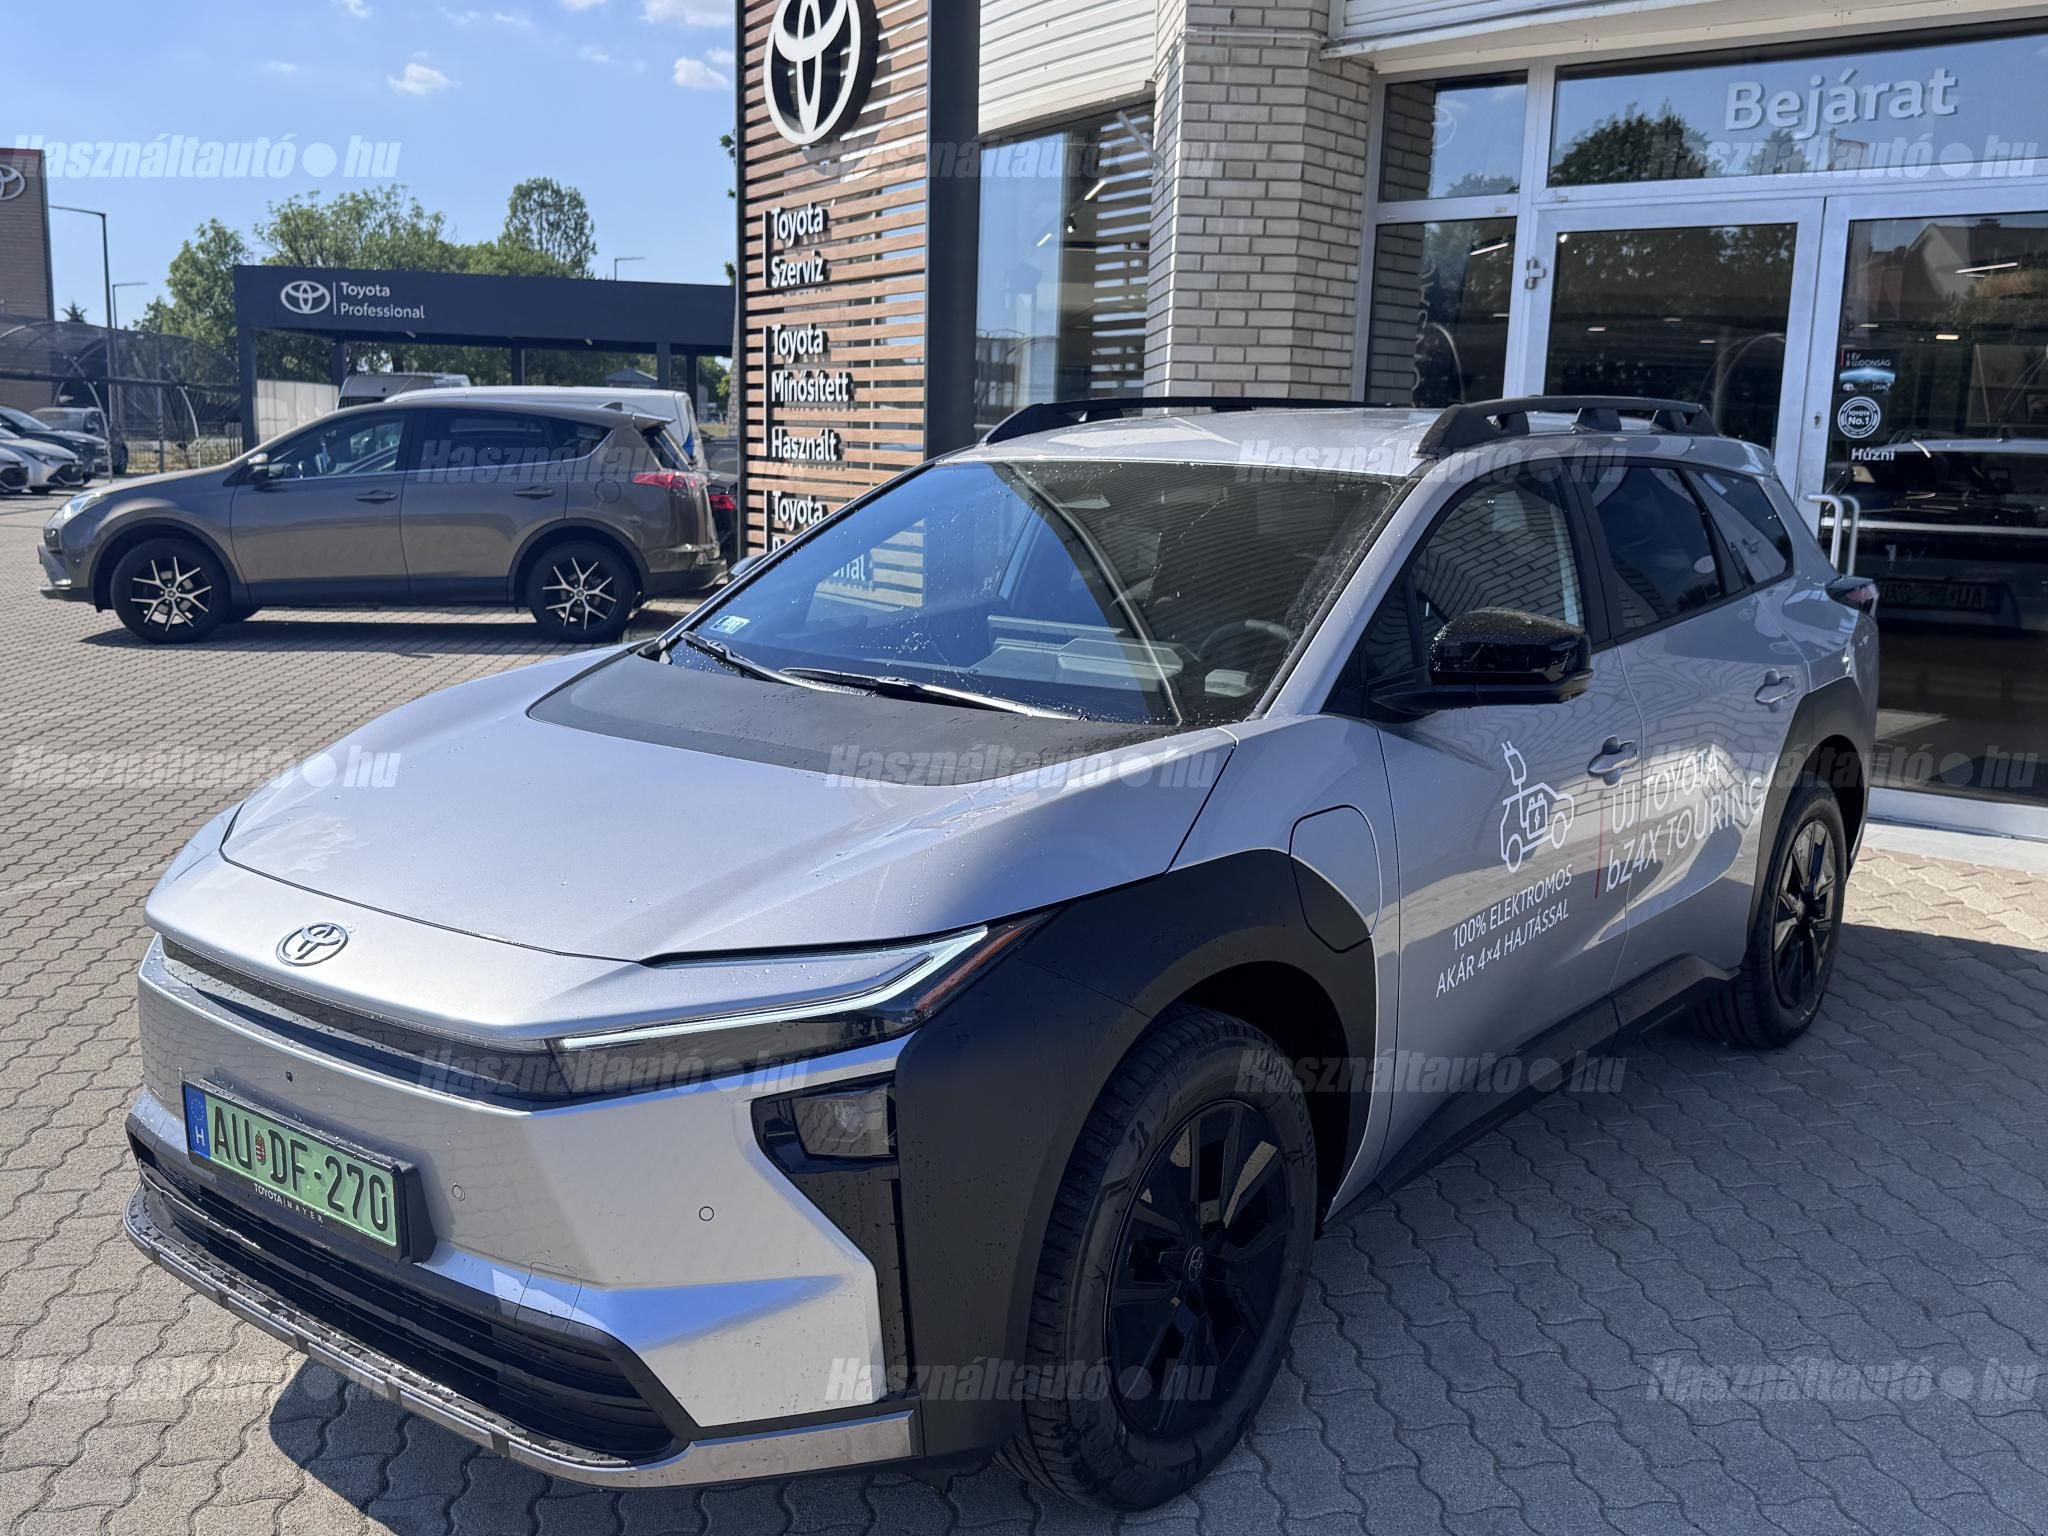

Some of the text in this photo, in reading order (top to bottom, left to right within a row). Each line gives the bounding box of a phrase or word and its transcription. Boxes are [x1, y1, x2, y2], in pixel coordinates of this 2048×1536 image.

[1725, 67, 1958, 140] Bejárat
[771, 203, 824, 246] Toyota
[771, 250, 824, 288] Szerviz
[340, 281, 391, 299] Toyota
[340, 302, 425, 319] Professional
[771, 324, 823, 363] Toyota
[771, 368, 849, 403] Minősített
[1848, 416, 1870, 425] No.1
[771, 427, 838, 462] Használt
[1851, 447, 1896, 461] Húzni
[772, 490, 823, 531] Toyota
[1612, 744, 1719, 833] ÚJ TOYOTA
[1606, 776, 1765, 892] bZ4X TOURING
[1453, 864, 1573, 950] 100% ELEKTROMOS
[1436, 955, 1475, 998] AKÁR
[1504, 897, 1570, 956] HAJTÁSSAL
[194, 1125, 206, 1147] H
[253, 1183, 283, 1206] TOYOTA
